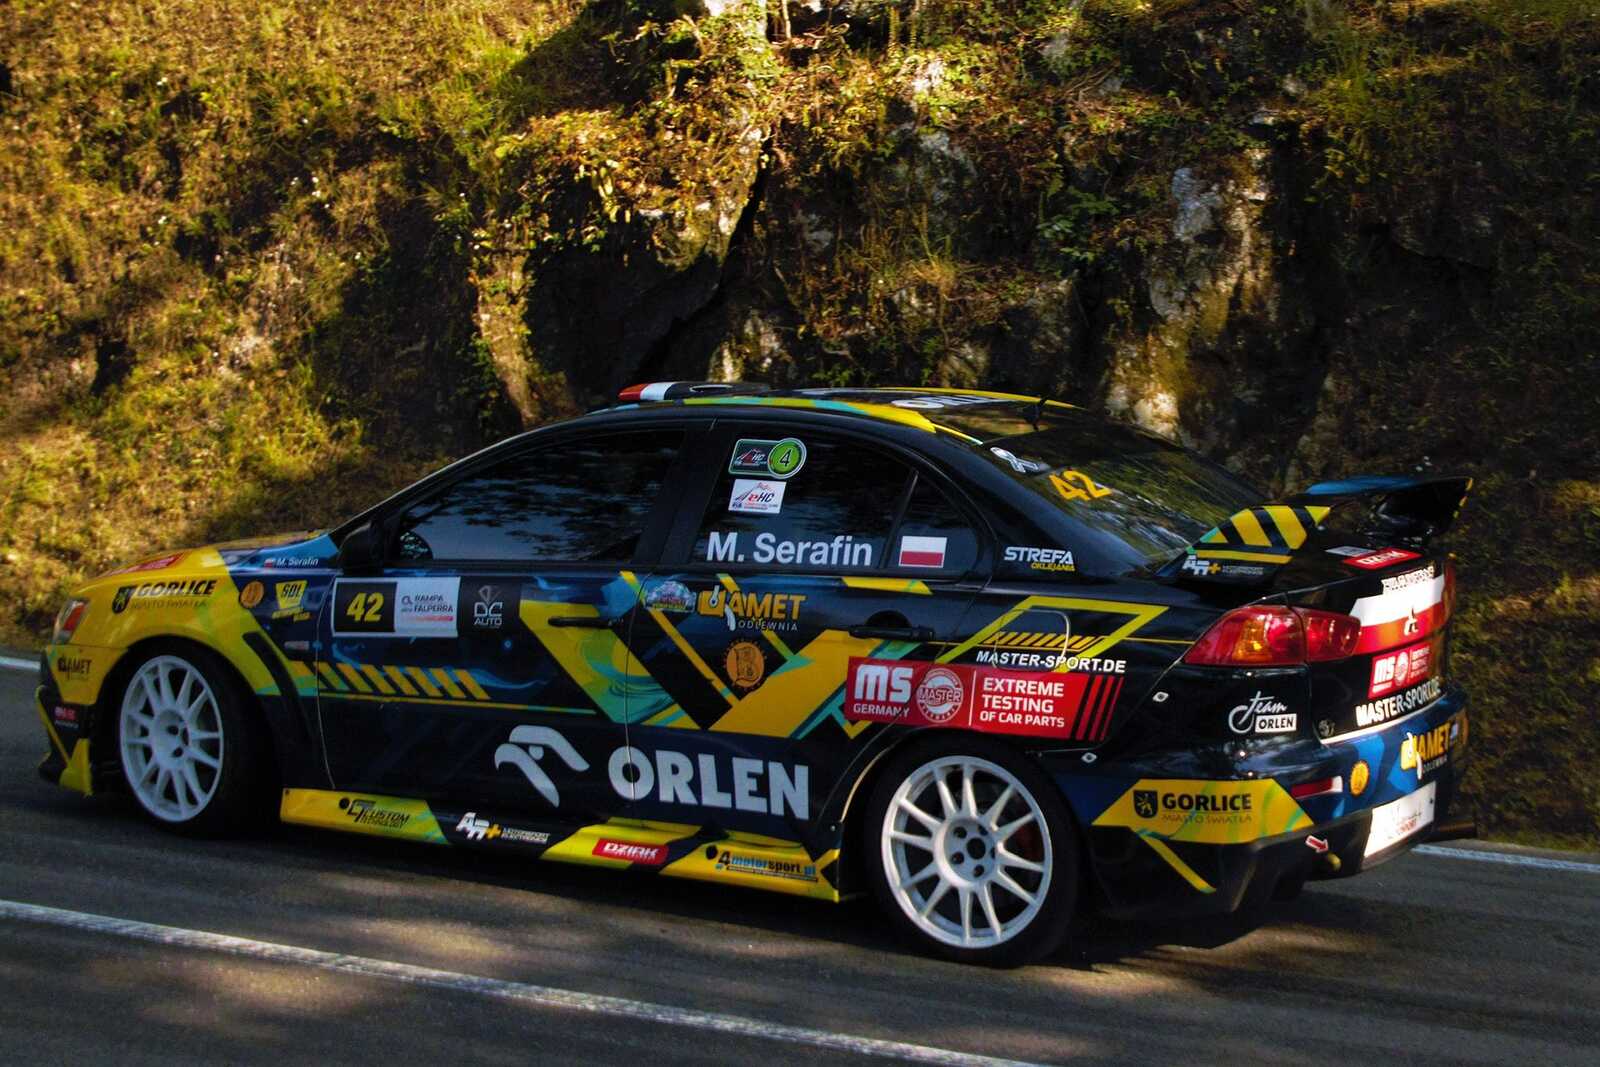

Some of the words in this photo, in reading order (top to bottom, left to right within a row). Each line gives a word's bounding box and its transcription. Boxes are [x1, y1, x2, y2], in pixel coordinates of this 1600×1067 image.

[780, 448, 792, 467] 4
[1049, 470, 1111, 501] 42
[706, 531, 744, 562] M.
[753, 532, 872, 566] Serafin
[1003, 546, 1074, 565] STREFA
[276, 558, 286, 566] M.
[288, 557, 319, 566] Serafin
[137, 579, 217, 597] GORLICE
[346, 592, 384, 622] 42
[474, 601, 503, 617] DC
[474, 617, 503, 626] AUTO
[738, 619, 798, 632] ODLEWNIA
[976, 650, 1127, 674] MASTER-SPORT.DE
[853, 663, 914, 704] MS
[982, 676, 1065, 698] EXTREME
[919, 685, 962, 704] MASTER
[981, 694, 1054, 713] TESTING
[853, 703, 910, 718] GERMANY
[979, 709, 997, 722] OF
[998, 711, 1022, 724] CAR
[1024, 712, 1065, 728] PARTS
[1258, 716, 1294, 730] ORLEN
[607, 745, 810, 820] ORLEN
[1162, 793, 1252, 811] GORLICE
